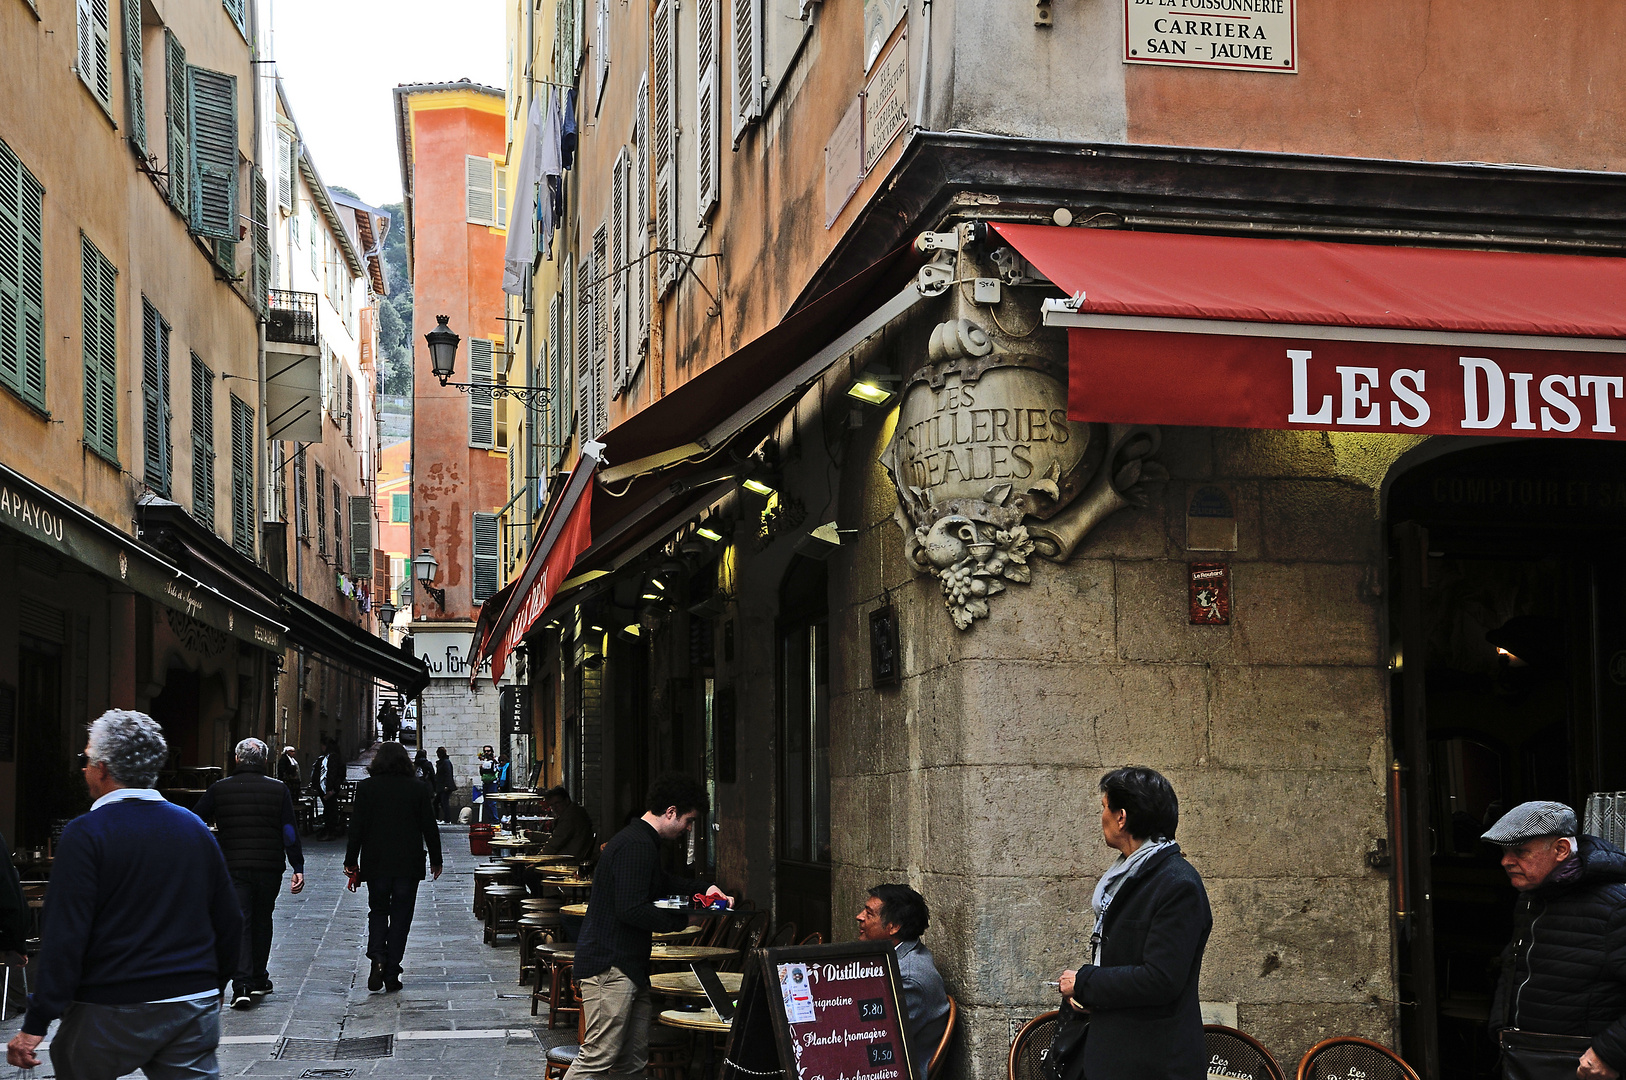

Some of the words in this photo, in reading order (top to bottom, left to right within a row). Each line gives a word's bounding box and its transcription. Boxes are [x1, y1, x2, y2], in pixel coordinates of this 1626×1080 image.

[1154, 18, 1267, 40] CARRIERA
[1147, 38, 1187, 55] SAN
[1210, 42, 1273, 60] JAUME
[880, 62, 891, 87] RUE
[873, 96, 899, 138] CARRIERA
[935, 383, 978, 414] LES
[1286, 349, 1431, 428] LES
[1431, 476, 1559, 506] COMPTOIR
[1565, 479, 1592, 507] ET
[1200, 570, 1224, 578] Routard
[254, 624, 279, 647] RESTAURANT
[513, 687, 521, 732] EPICERIE
[822, 961, 885, 982] Distilleries
[811, 995, 853, 1012] rignotine
[862, 1003, 883, 1017] 5.80
[803, 1029, 843, 1048] Planche
[844, 1028, 888, 1048] fromagère
[872, 1049, 893, 1061] 9.50
[1209, 1054, 1229, 1067] Les
[1347, 1066, 1366, 1079] Les
